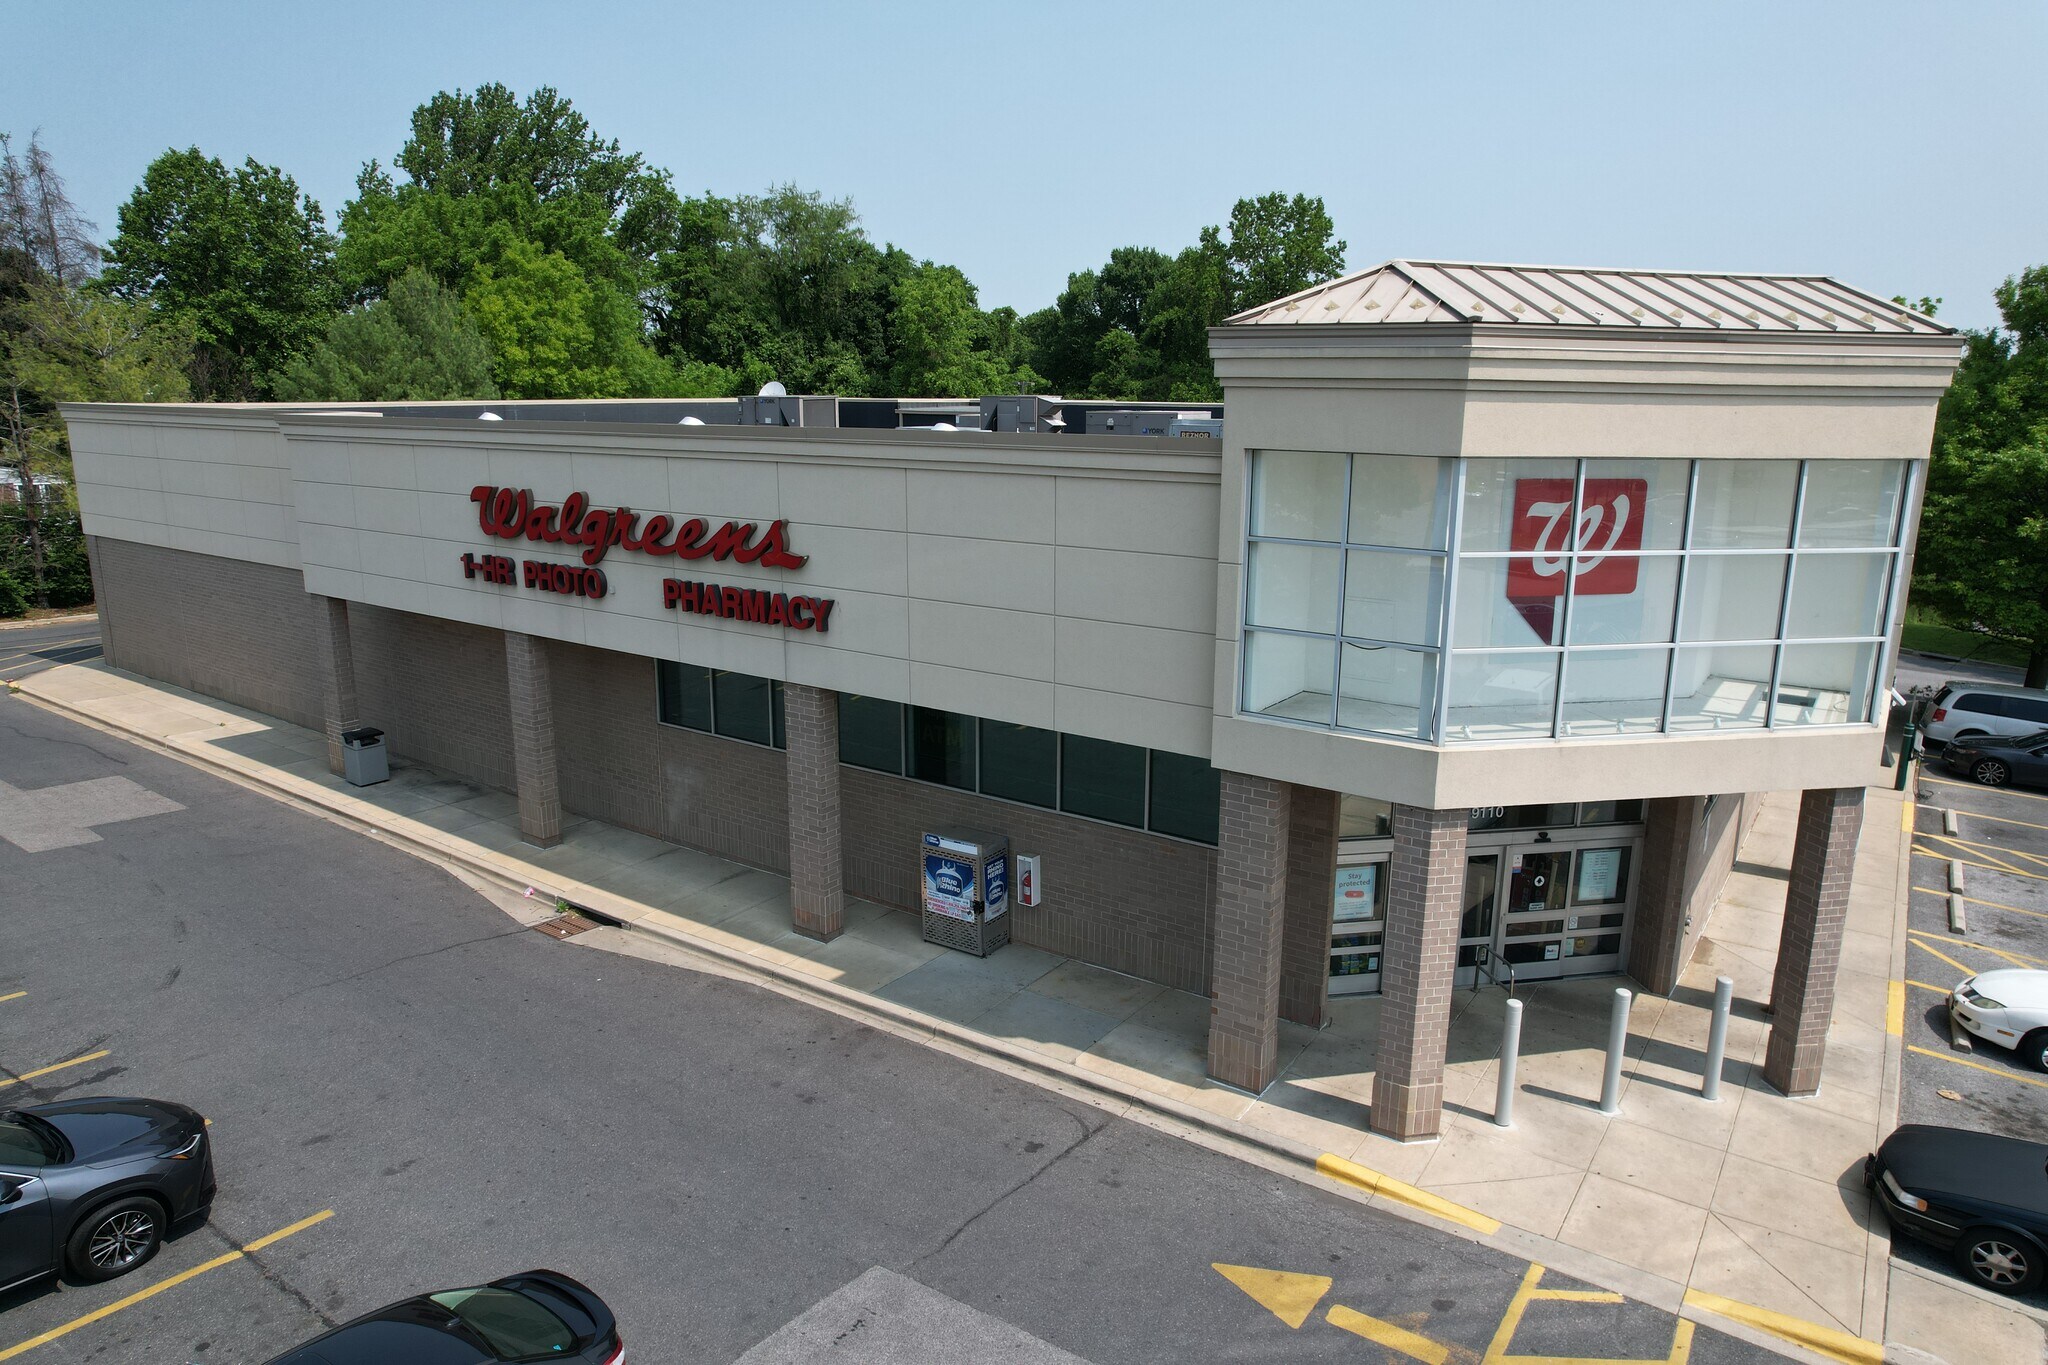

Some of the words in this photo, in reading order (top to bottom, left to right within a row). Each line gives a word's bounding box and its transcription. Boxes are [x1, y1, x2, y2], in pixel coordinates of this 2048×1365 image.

[470, 485, 809, 570] Walgreens
[1526, 494, 1630, 577] W
[460, 553, 516, 585] 1-HR
[523, 560, 607, 599] PHOTO
[663, 578, 835, 632] PHARMACY
[1472, 806, 1504, 819] 9110
[1338, 878, 1371, 889] protected
[1347, 872, 1363, 880] Stay
